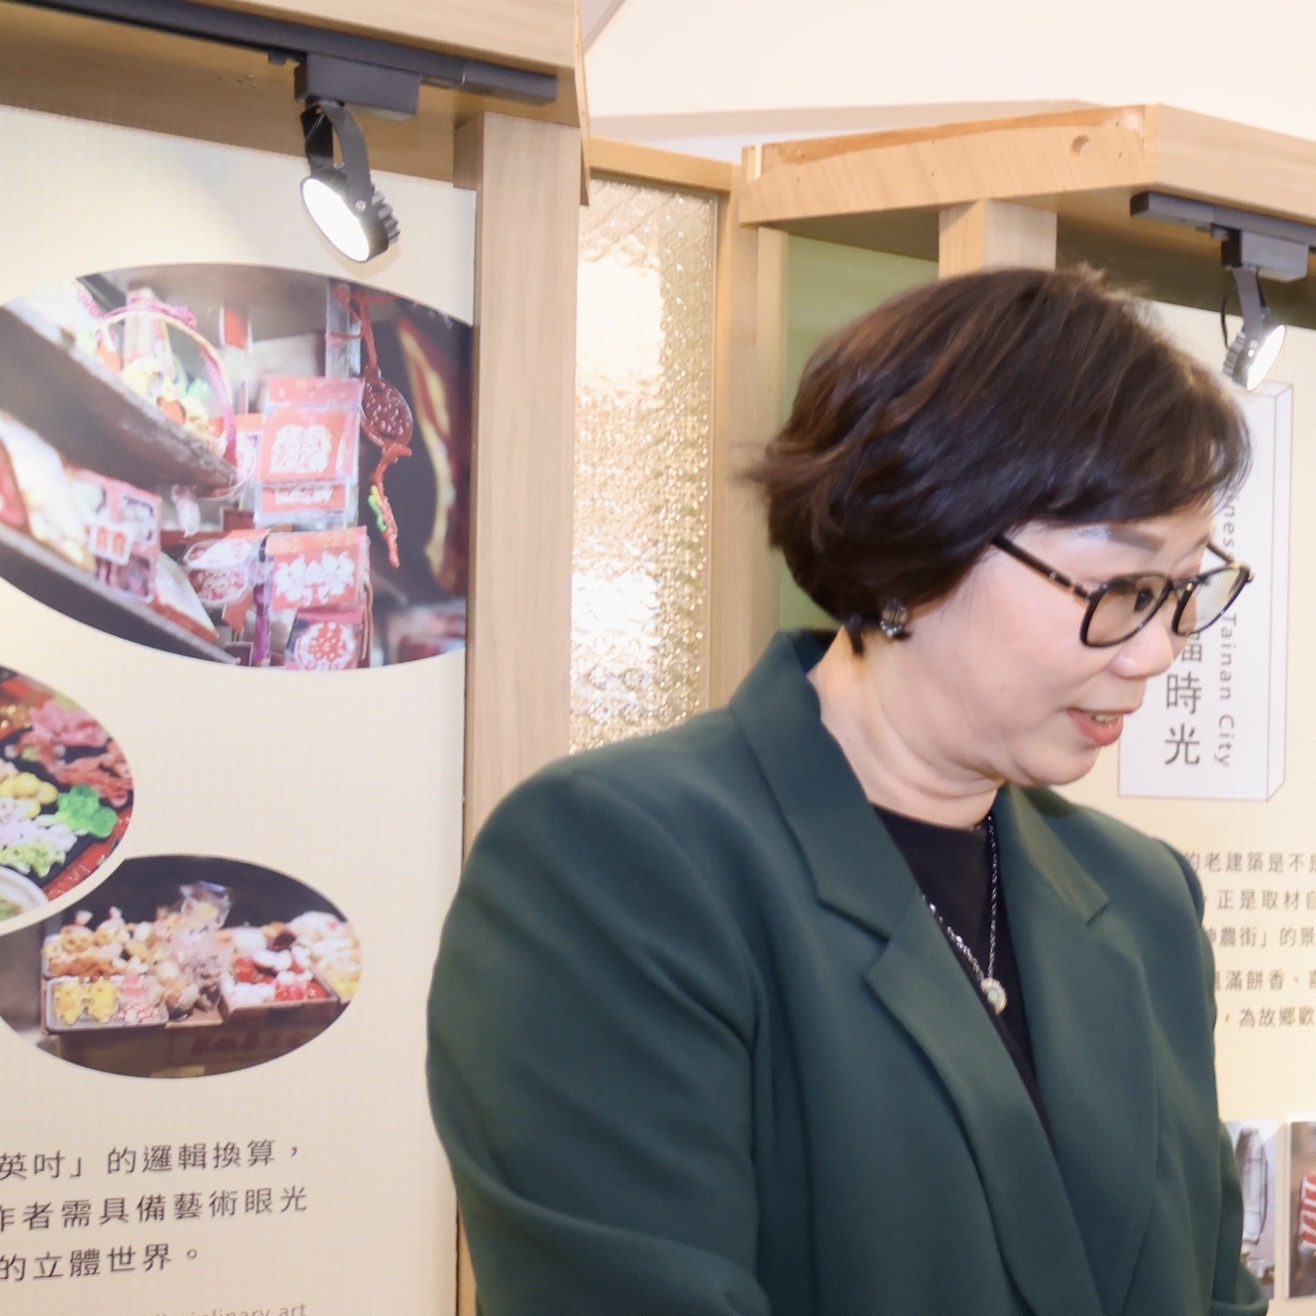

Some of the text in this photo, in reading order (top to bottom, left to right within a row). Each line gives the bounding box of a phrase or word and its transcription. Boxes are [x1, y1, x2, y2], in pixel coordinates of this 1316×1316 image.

[1219, 613, 1237, 700] Tainan
[1214, 714, 1235, 767] City
[0, 1243, 199, 1283] 的立體世界。
